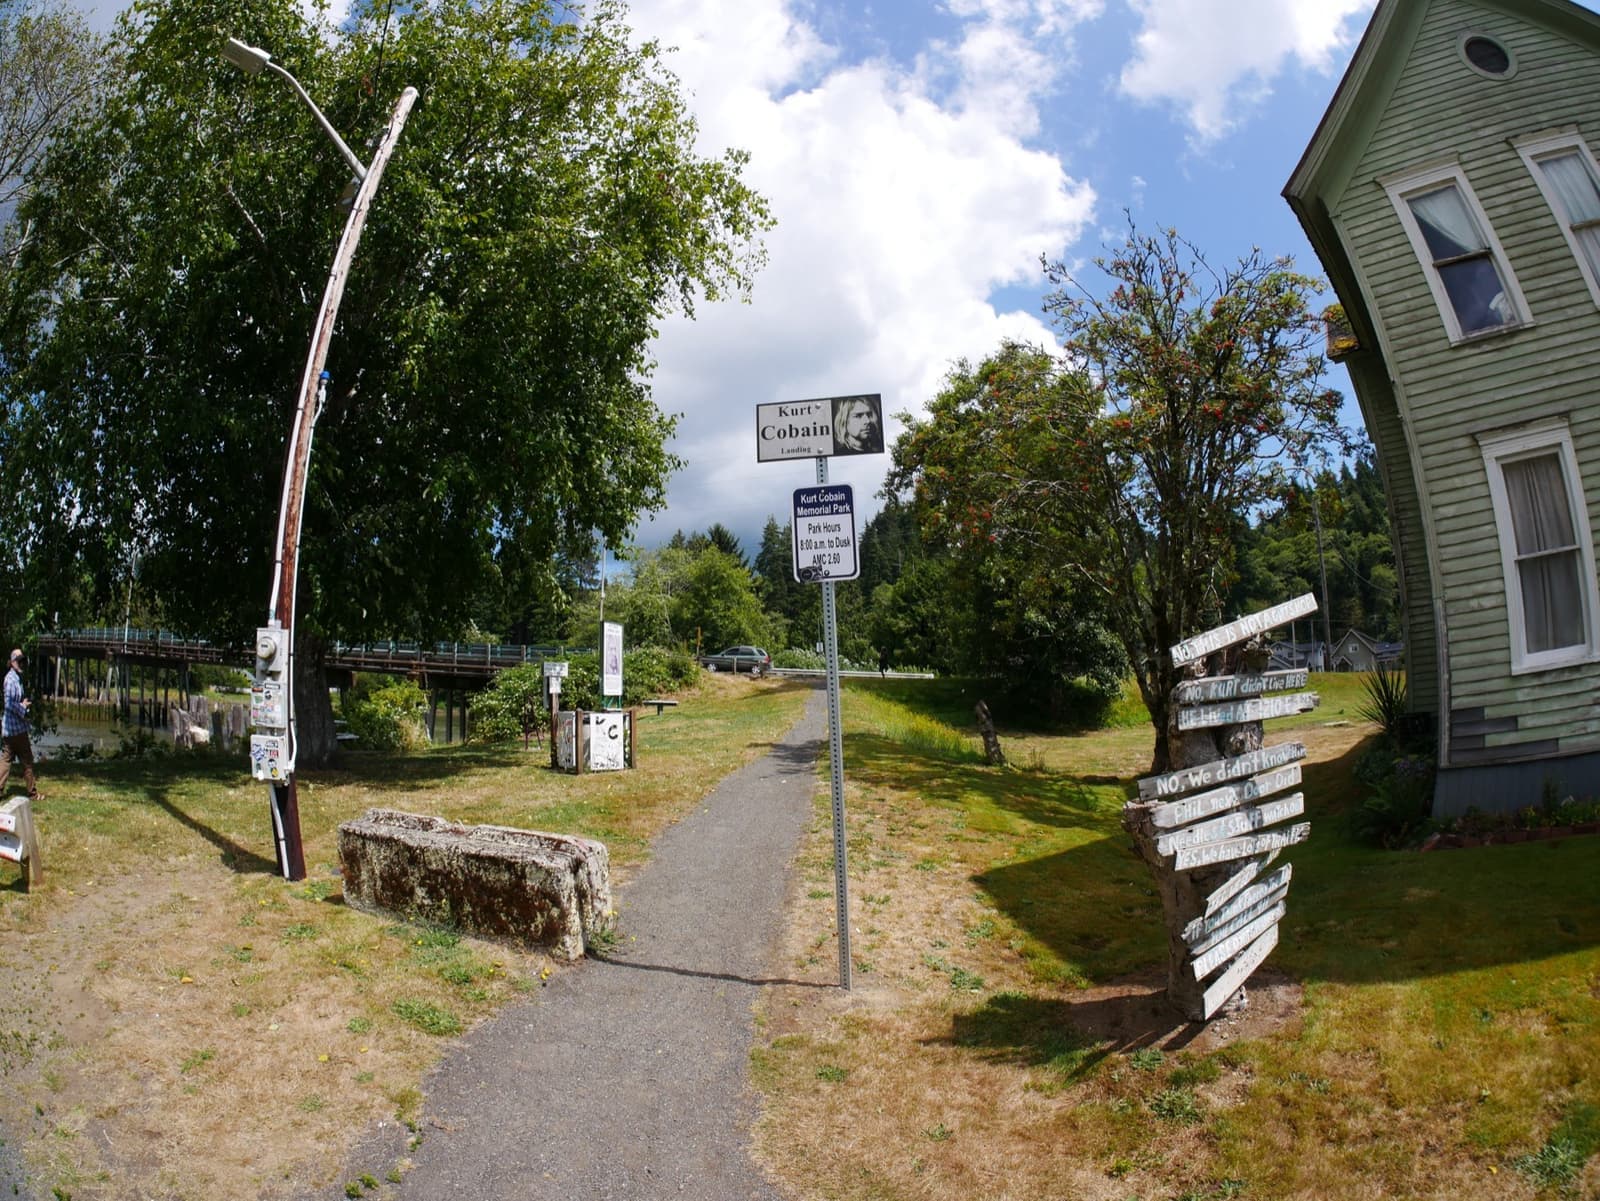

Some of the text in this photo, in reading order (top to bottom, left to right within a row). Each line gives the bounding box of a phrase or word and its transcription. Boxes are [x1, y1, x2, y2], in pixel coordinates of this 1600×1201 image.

[778, 405, 812, 417] Kurt
[761, 421, 830, 441] Cobain
[781, 447, 811, 455] Landing
[800, 492, 846, 504] Kurt Cobain
[797, 503, 851, 516] Memorial Park
[808, 522, 841, 535] Park Hours
[800, 536, 851, 551] 8:00 a.m. to Dusk
[812, 552, 841, 566] AMC 2.60
[1226, 627, 1237, 642] IS
[1241, 614, 1264, 638] NOT
[1285, 672, 1307, 688] HERE
[1156, 774, 1186, 796] NO,
[1189, 769, 1212, 787] We
